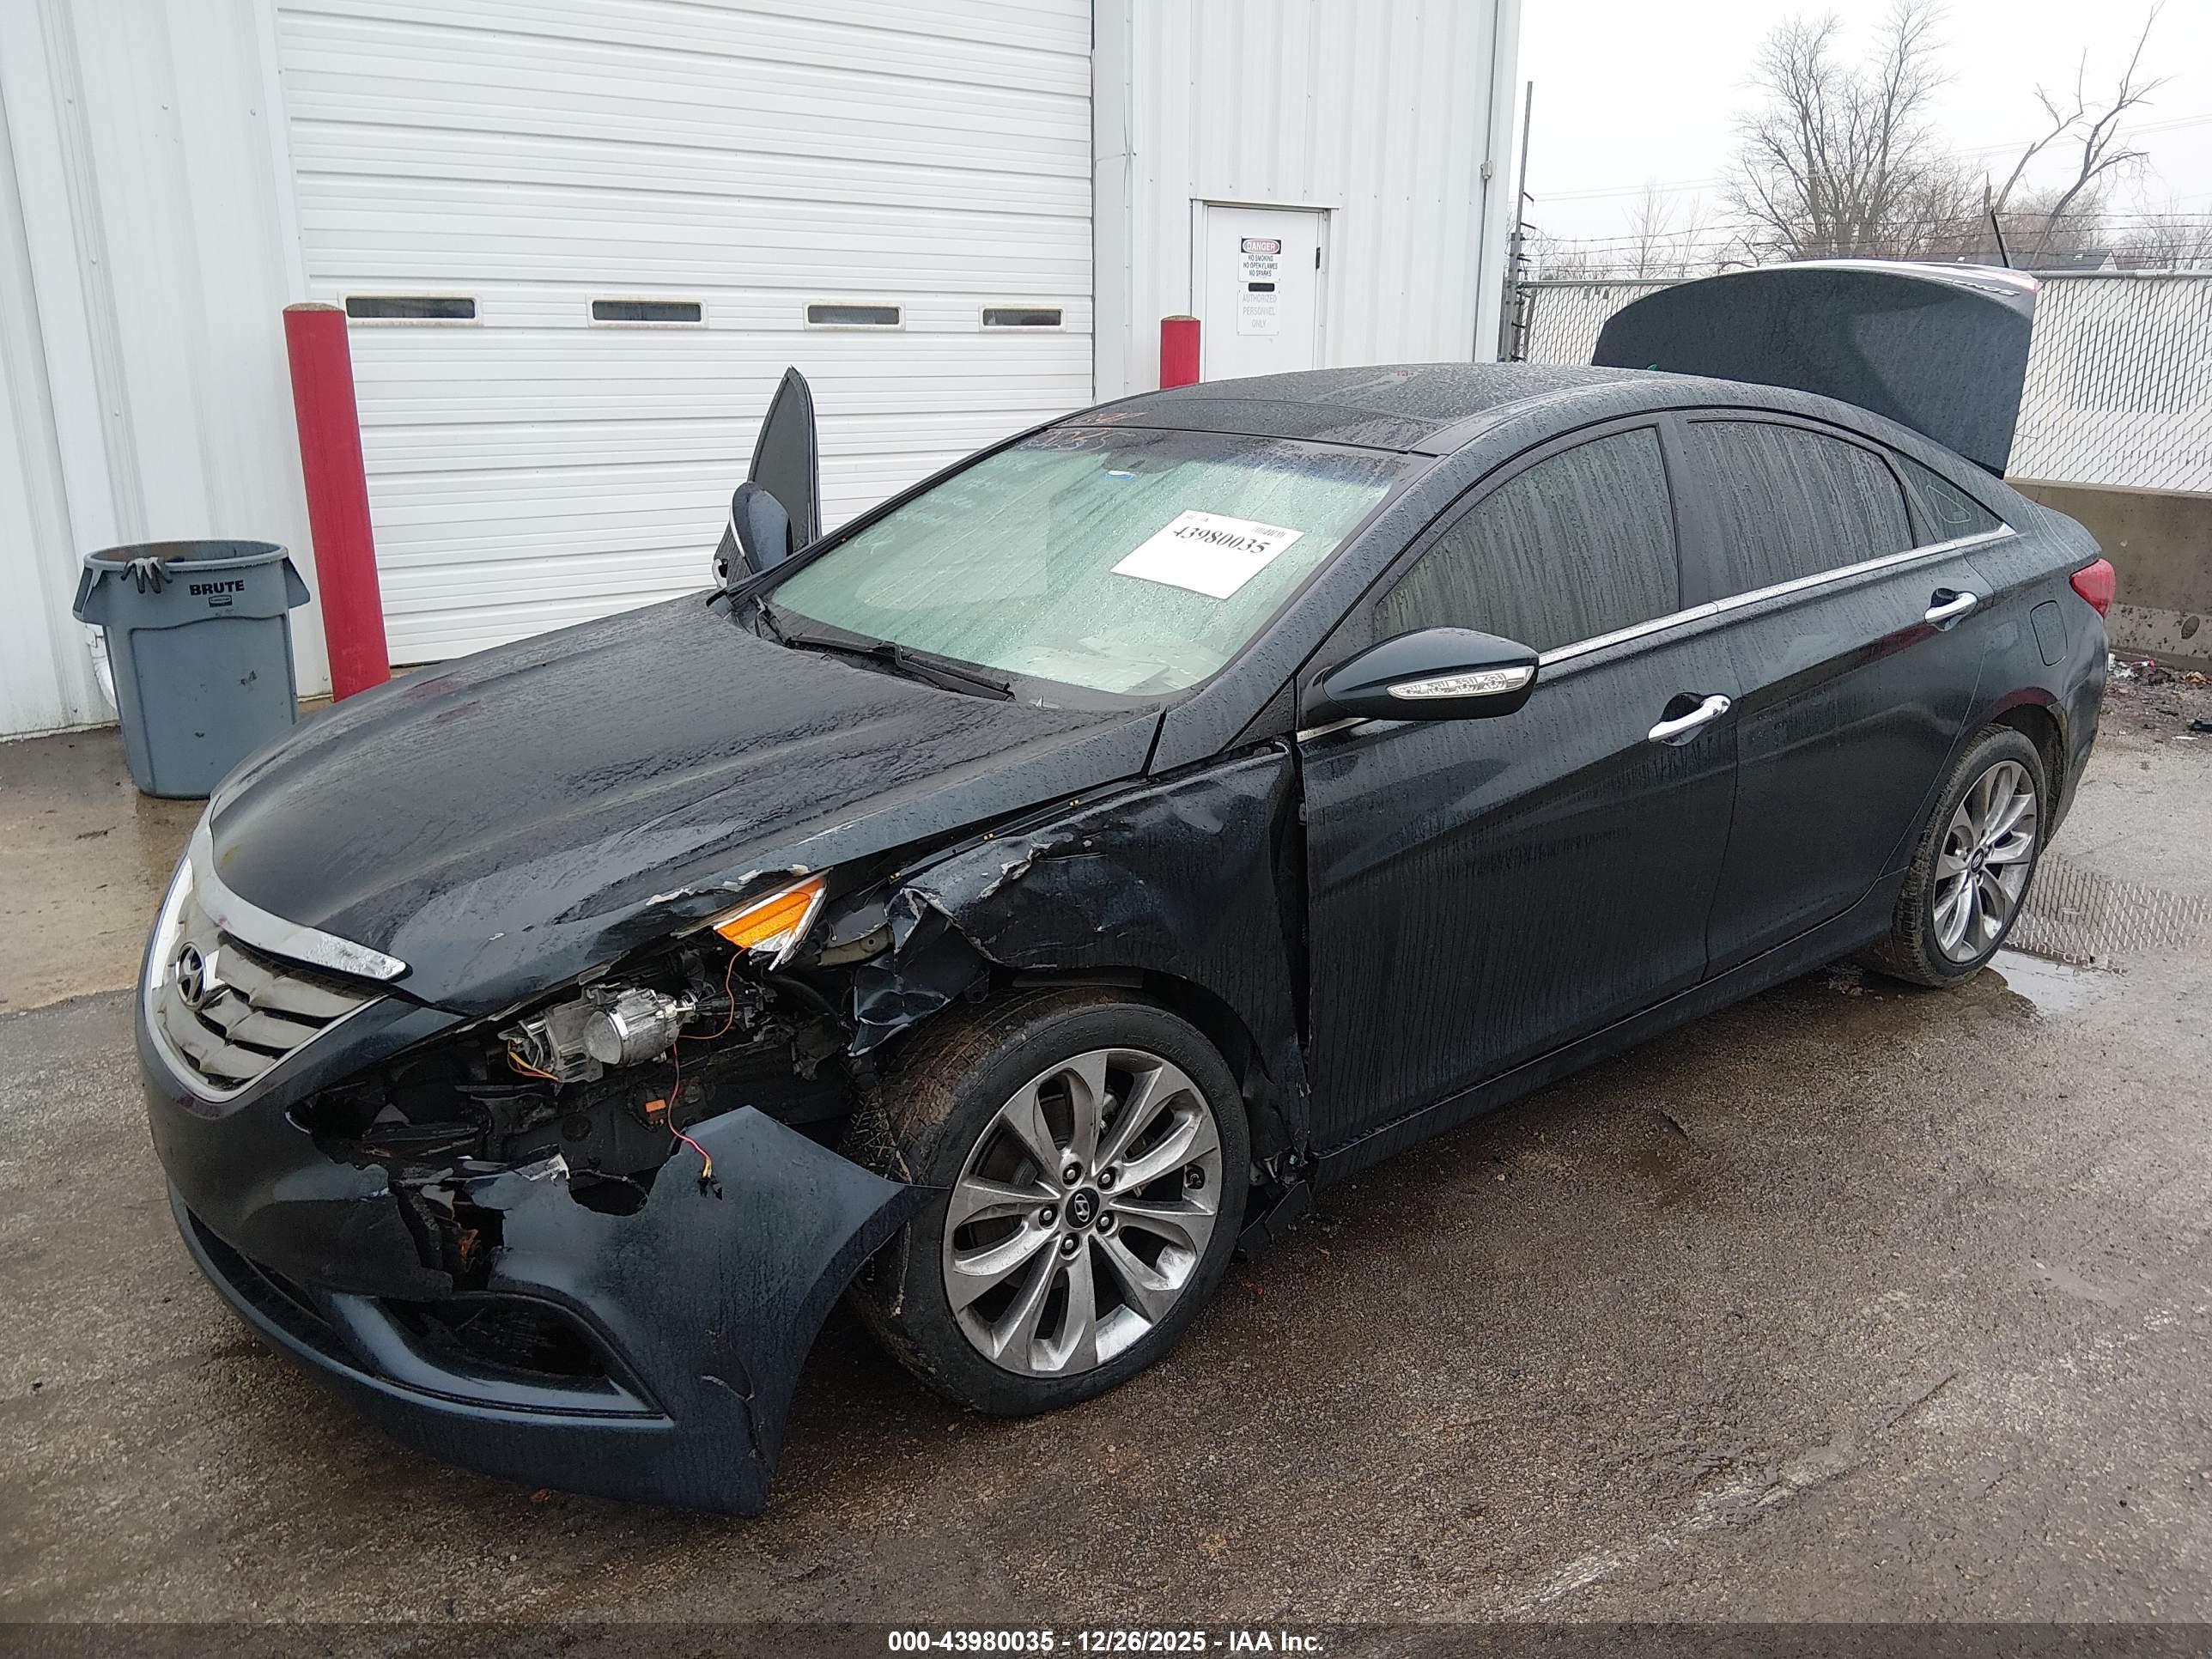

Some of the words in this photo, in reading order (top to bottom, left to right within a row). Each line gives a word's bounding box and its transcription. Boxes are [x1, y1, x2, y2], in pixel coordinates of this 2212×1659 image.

[1247, 241, 1276, 252] DANGER
[1242, 294, 1278, 303] AUTHORIZED
[1243, 307, 1276, 316] PERSONNEL
[1251, 319, 1267, 328] ONLY
[1173, 526, 1271, 554] 43980035
[189, 580, 245, 596] BRUTE
